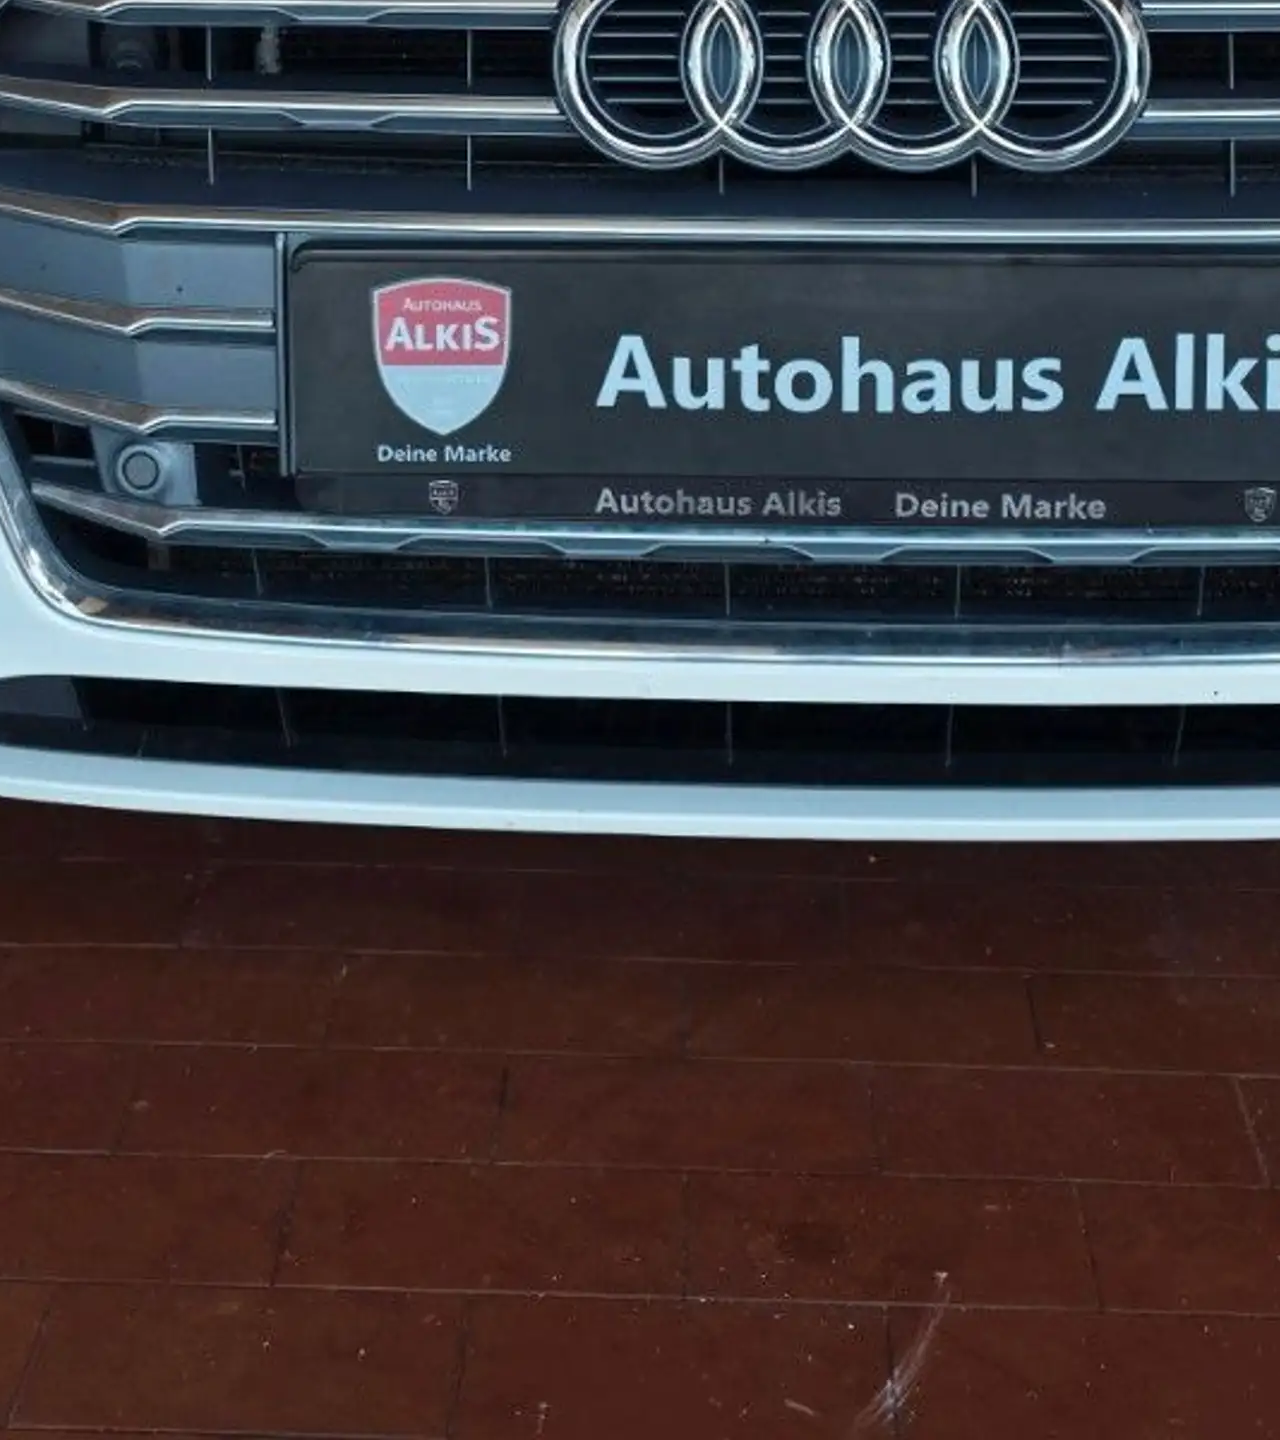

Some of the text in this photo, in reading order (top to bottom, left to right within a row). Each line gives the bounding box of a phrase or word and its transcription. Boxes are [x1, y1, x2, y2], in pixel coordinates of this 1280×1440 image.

[403, 297, 482, 312] AUTOHAUS
[385, 316, 500, 351] ALKIS
[596, 334, 1064, 413] Autohaus
[377, 444, 512, 462] Deine Marke
[595, 488, 842, 518] Autohaus Alkis
[894, 492, 1107, 520] Deine Marke
